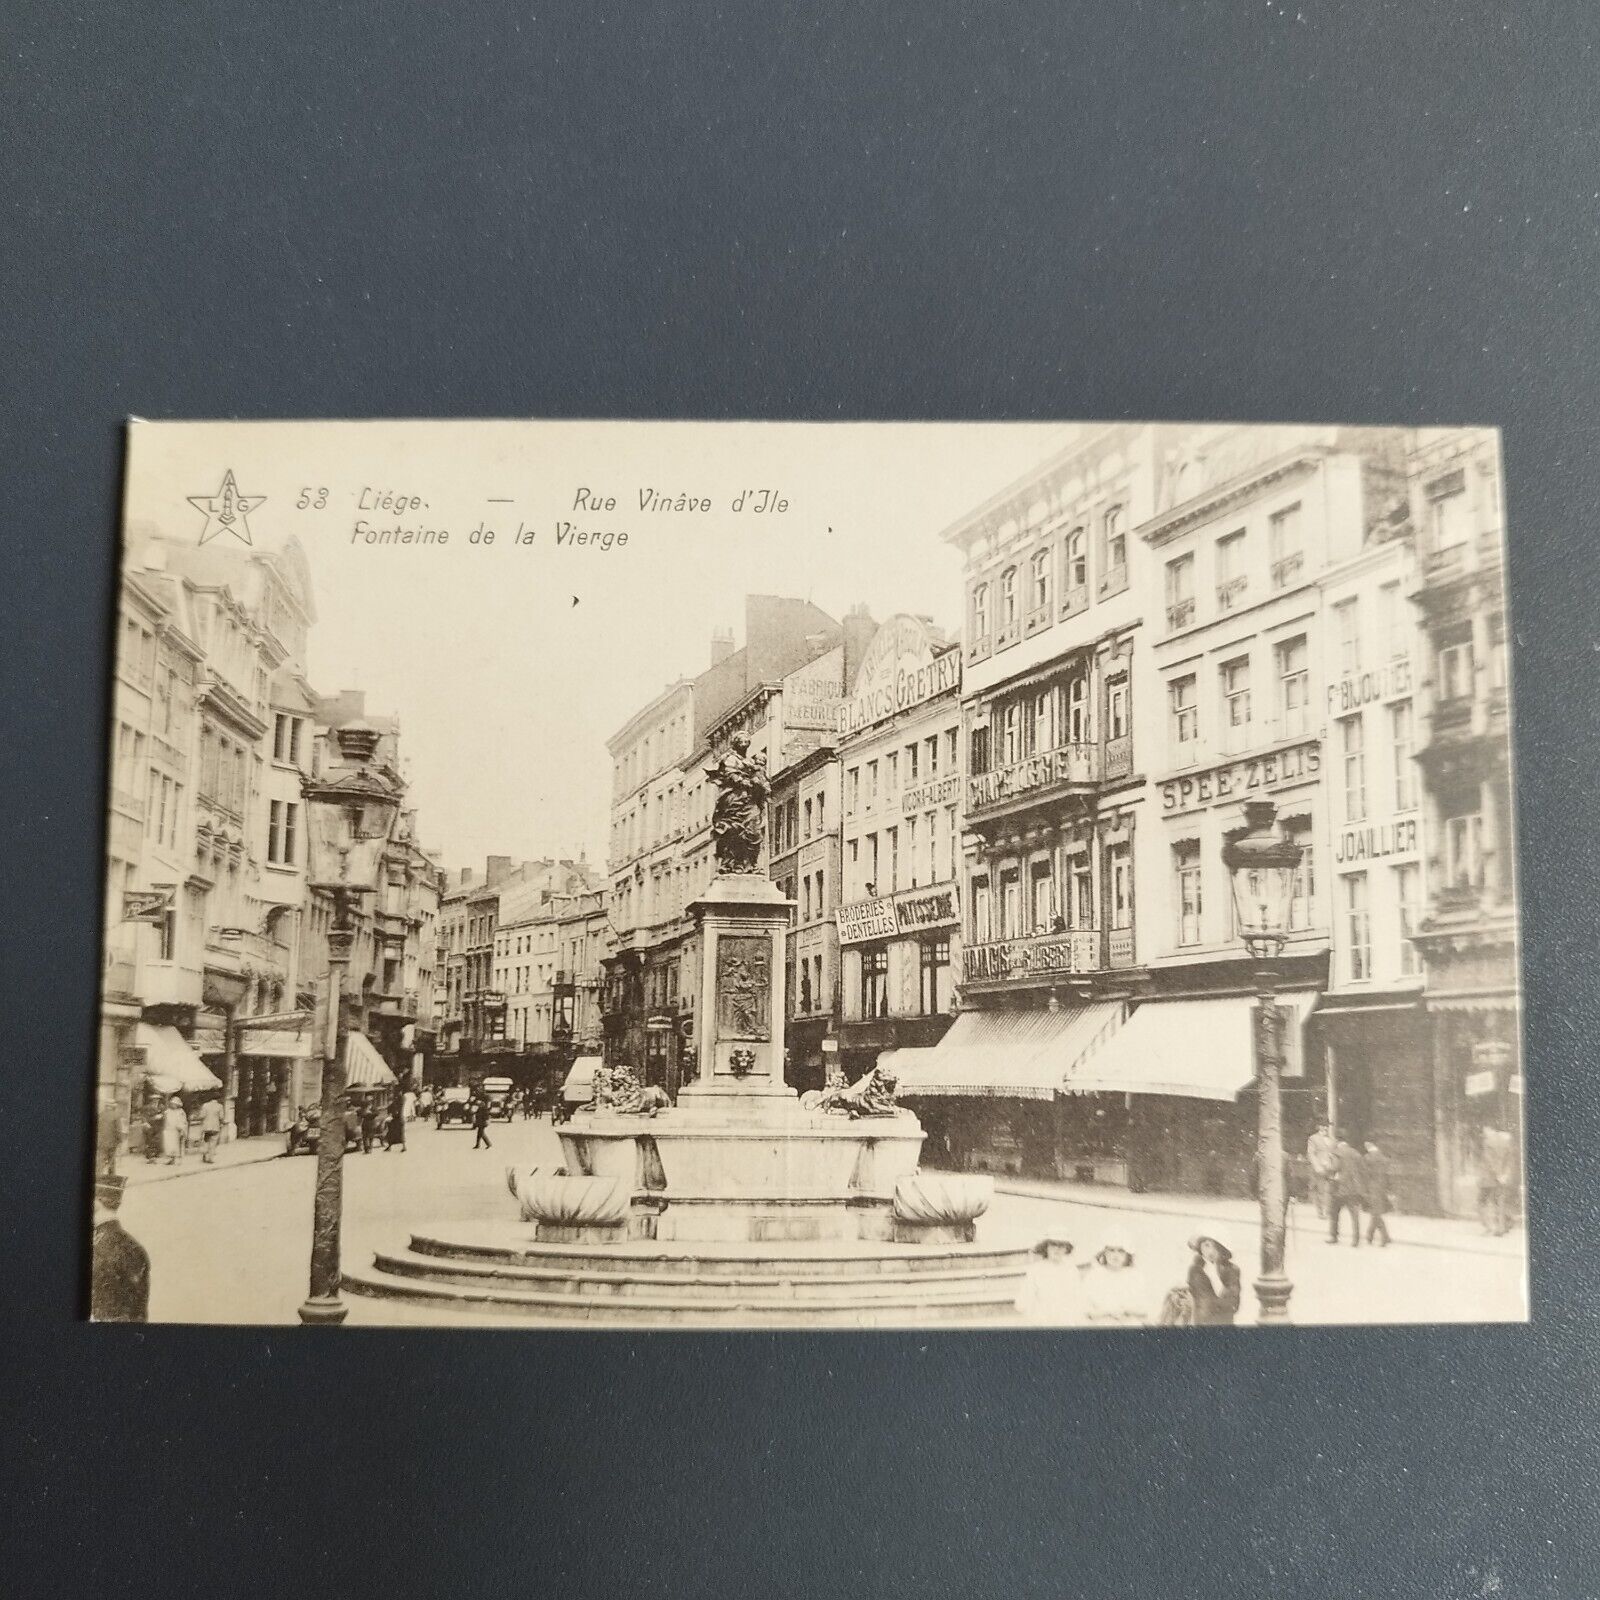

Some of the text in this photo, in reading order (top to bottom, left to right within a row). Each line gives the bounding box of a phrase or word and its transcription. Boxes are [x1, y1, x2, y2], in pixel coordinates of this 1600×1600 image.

[296, 487, 330, 510] 53
[572, 487, 617, 512] Rue
[638, 487, 712, 513] Vinâve
[350, 520, 629, 551] Fontaine de la Vierge
[791, 676, 846, 698] FABRIQU
[840, 684, 894, 734] BLANCS
[896, 651, 960, 708] GRETRY
[838, 900, 885, 924] BRODERIES
[846, 916, 895, 940] DENTELLES
